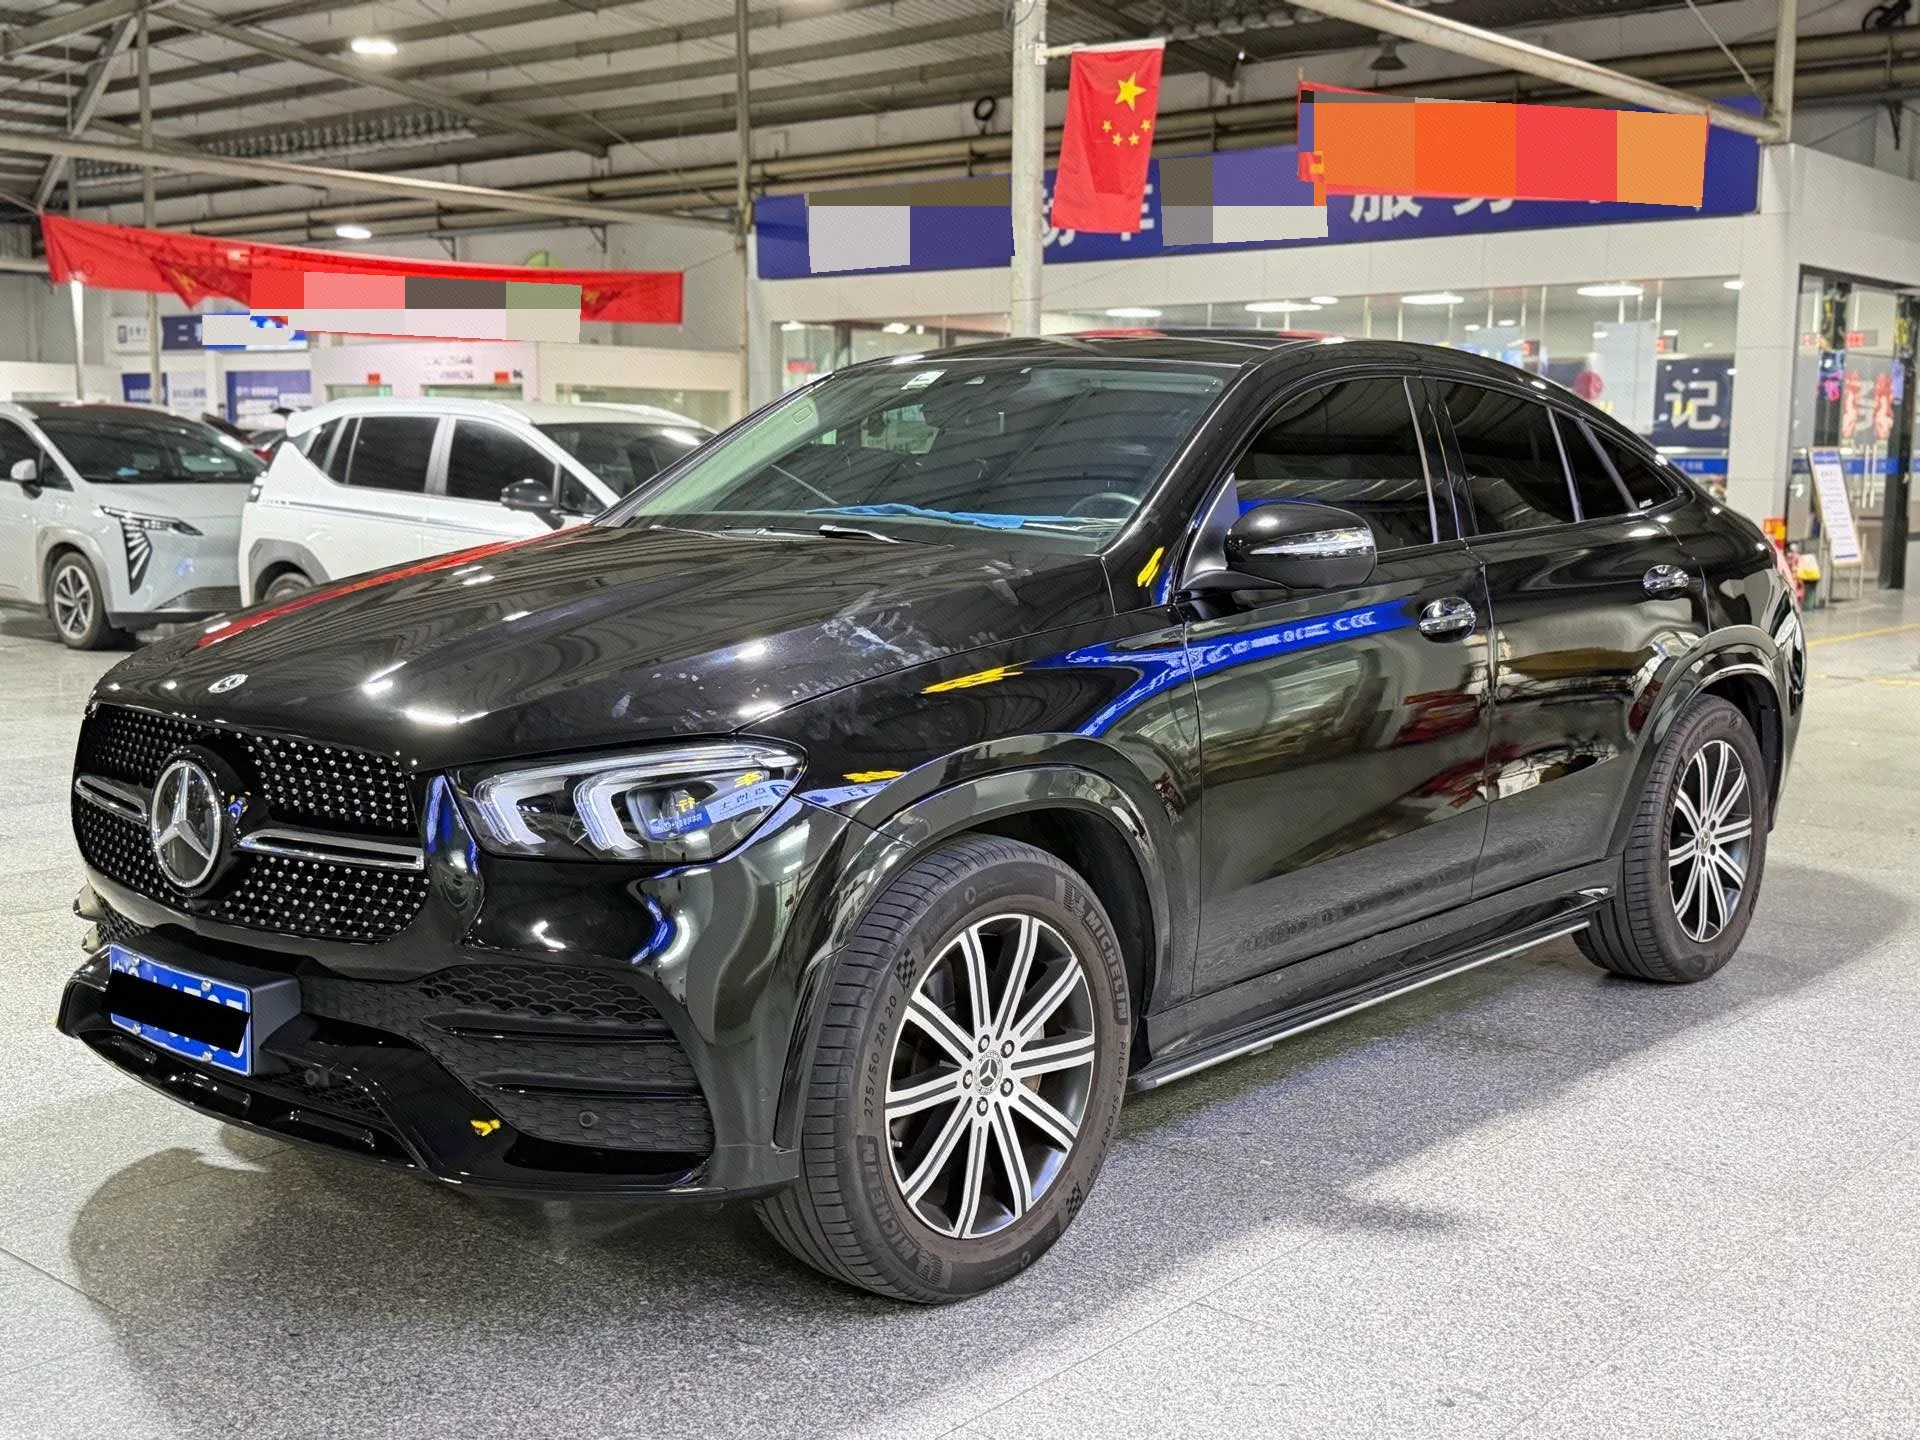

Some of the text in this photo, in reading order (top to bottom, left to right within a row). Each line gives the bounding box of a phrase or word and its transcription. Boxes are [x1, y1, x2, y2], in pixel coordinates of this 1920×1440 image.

[1664, 379, 1721, 430] 记
[1086, 909, 1127, 1020] MICHELIN
[864, 995, 897, 1117] 275/50 ZR 20
[1116, 1041, 1126, 1089] PILOT
[1101, 1095, 1119, 1149] SPORT
